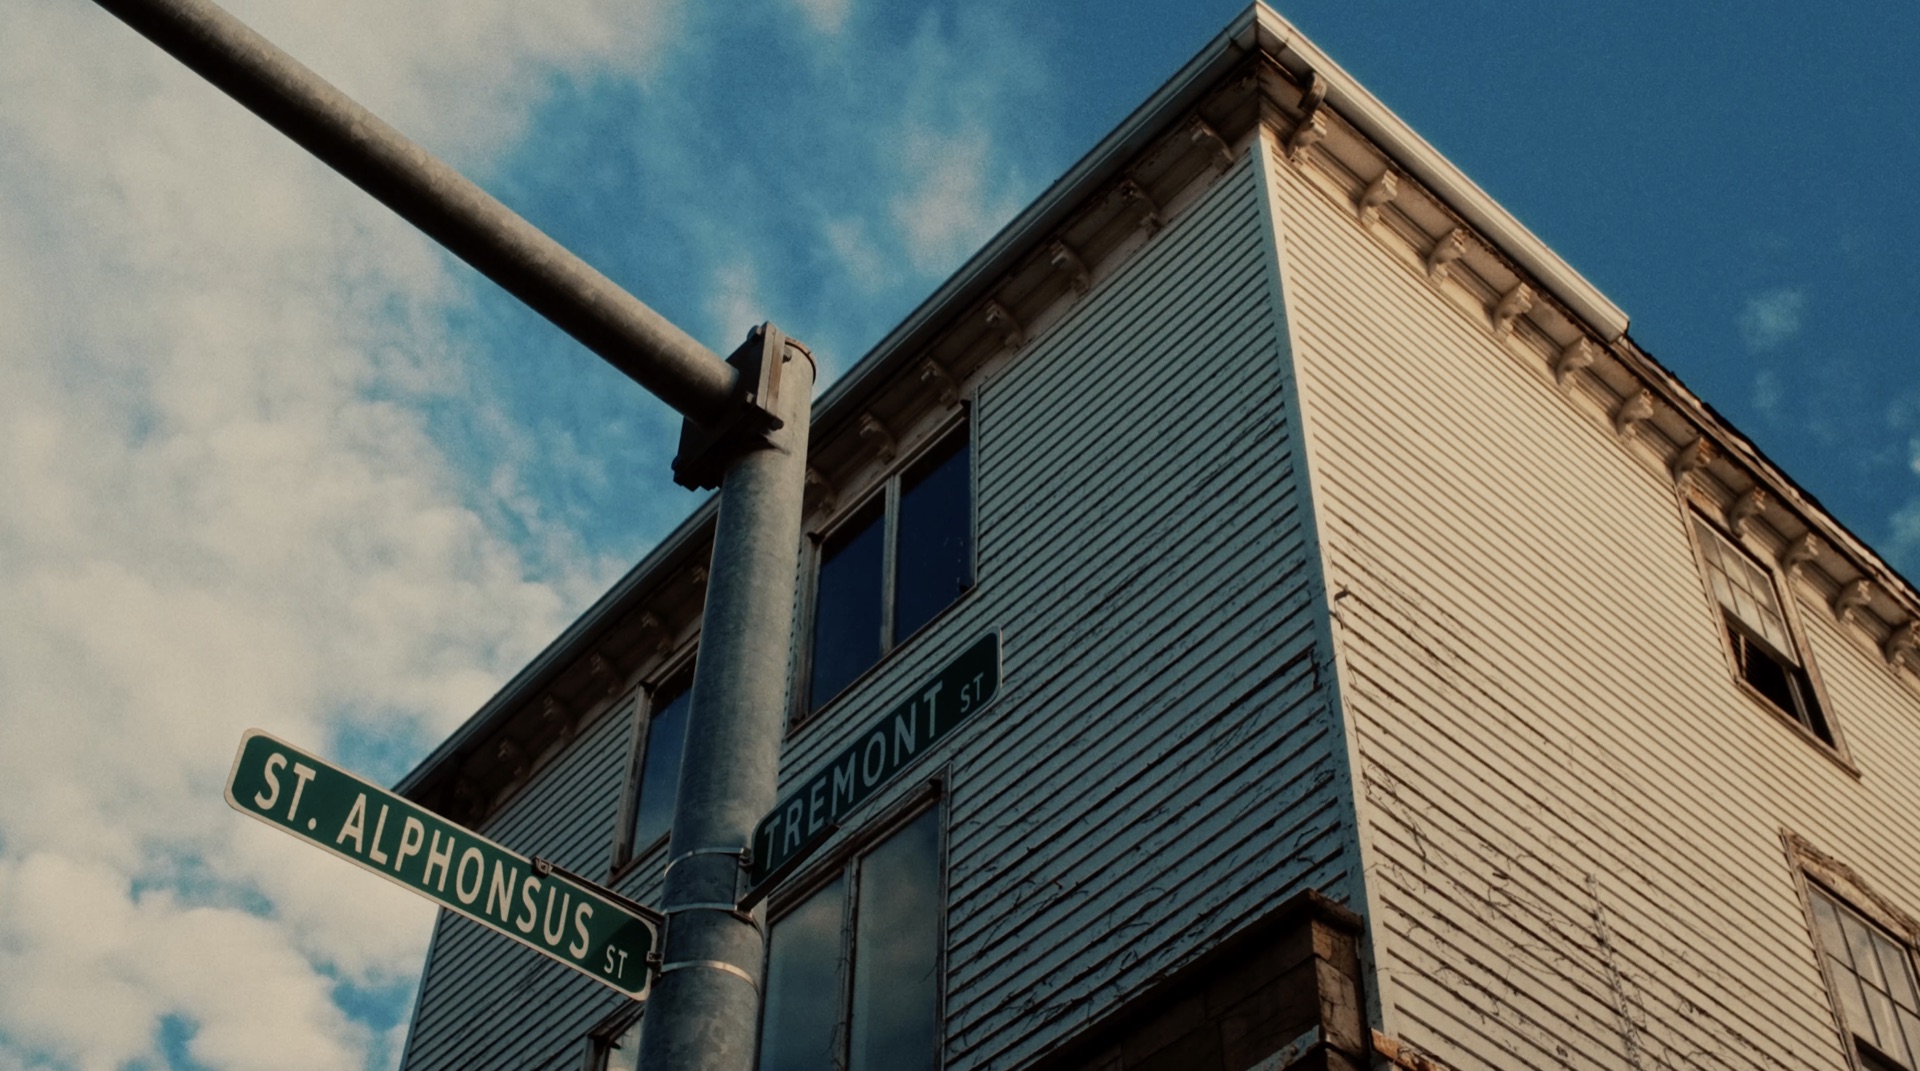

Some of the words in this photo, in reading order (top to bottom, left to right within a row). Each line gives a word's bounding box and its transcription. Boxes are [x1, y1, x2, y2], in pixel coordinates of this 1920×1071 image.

[254, 752, 316, 831] ST.
[336, 793, 594, 960] ALPHONSUS
[604, 944, 628, 979] ST
[764, 680, 943, 870] TREMONT
[960, 672, 984, 713] ST
